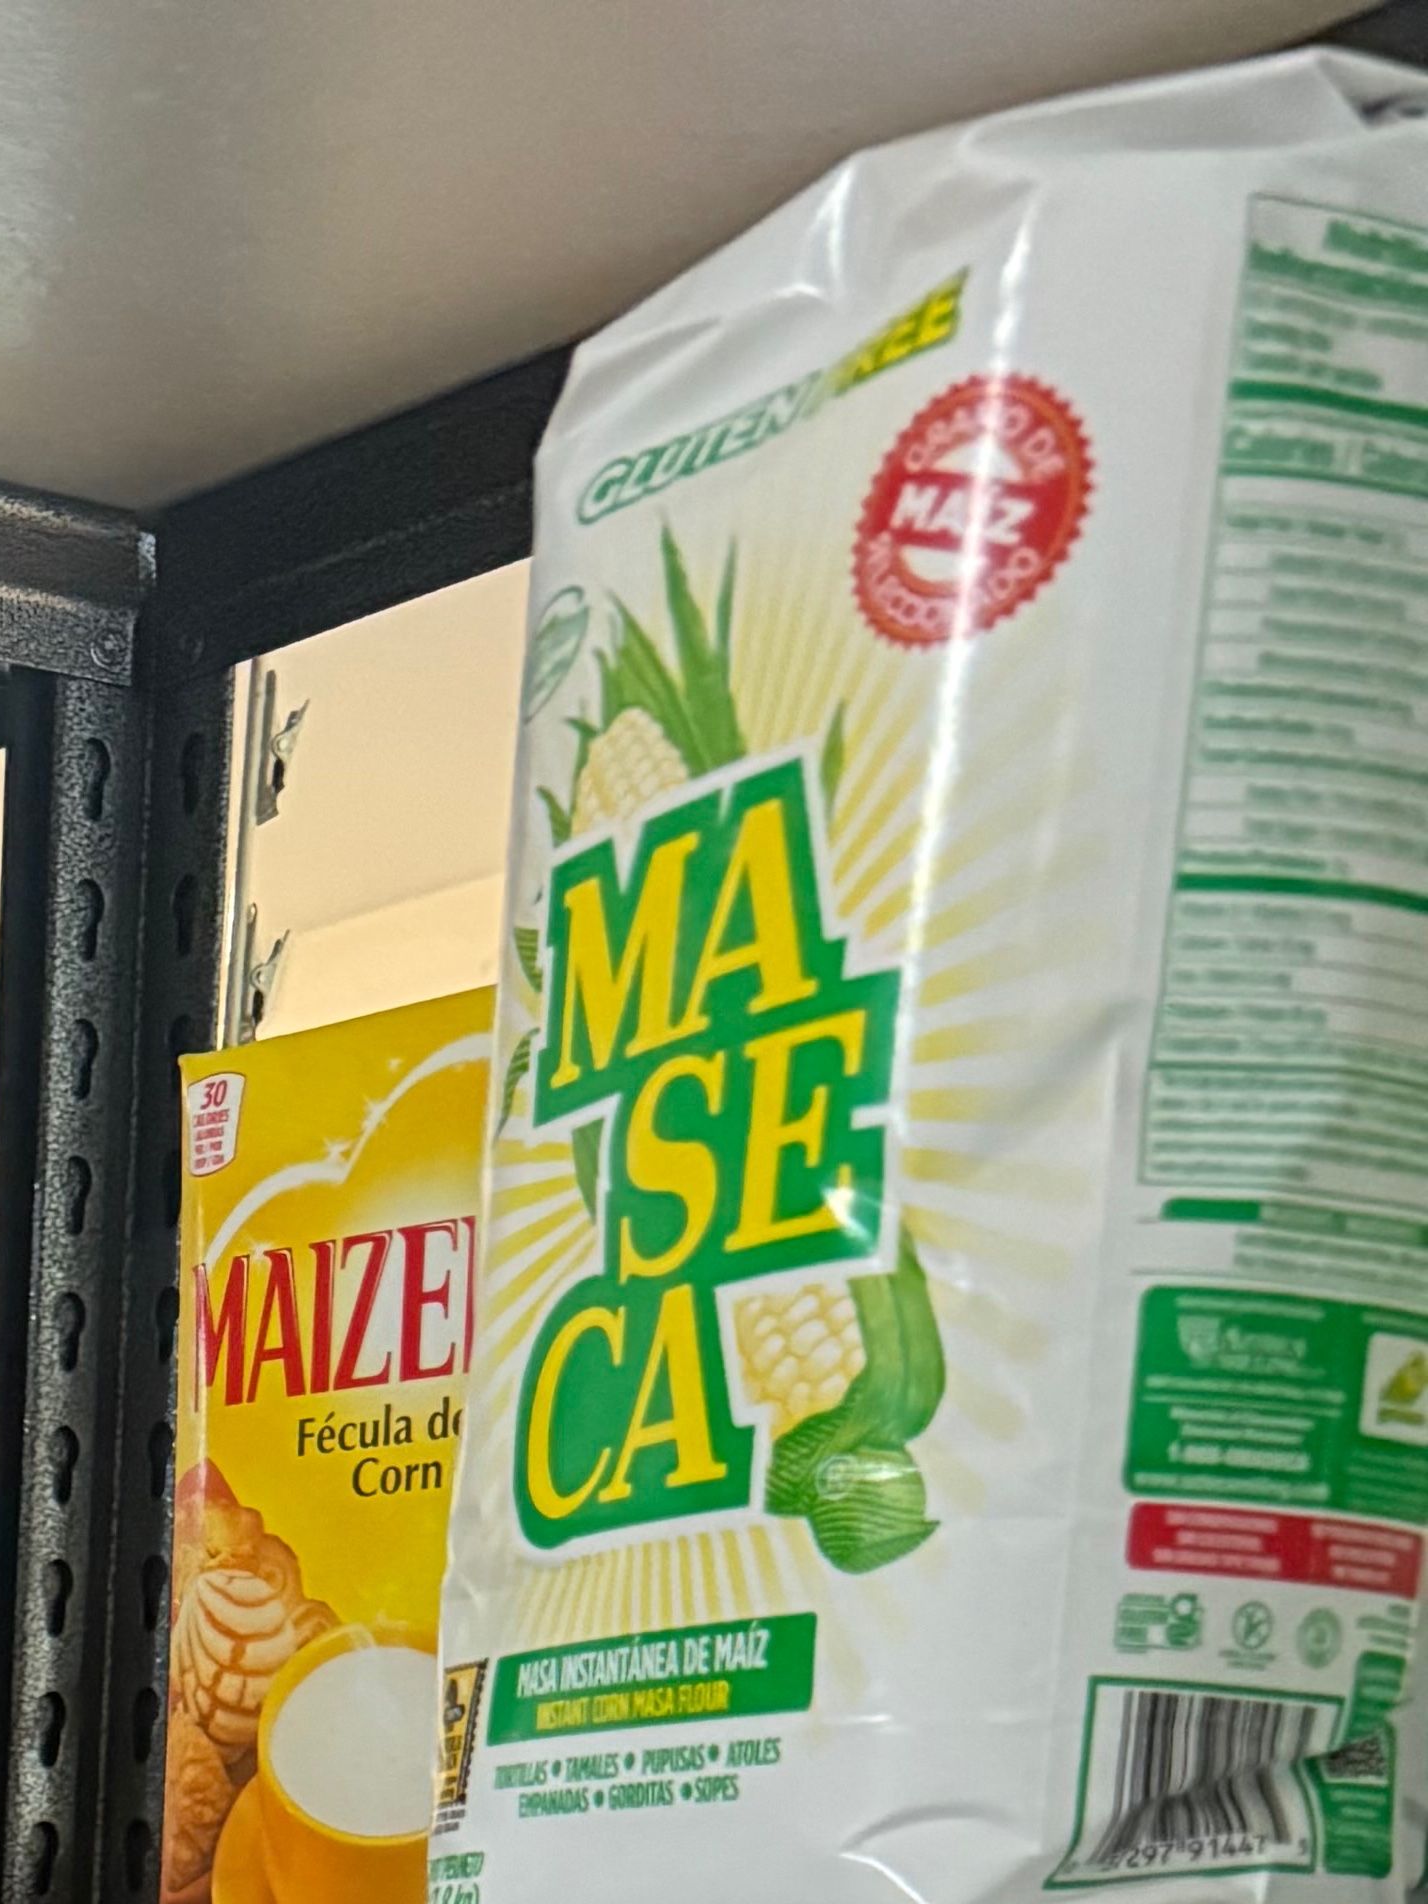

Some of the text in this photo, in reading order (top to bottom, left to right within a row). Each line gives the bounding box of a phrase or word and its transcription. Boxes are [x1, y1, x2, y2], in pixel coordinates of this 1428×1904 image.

[578, 374, 816, 526] GLUTEN
[548, 797, 822, 1091] MA
[199, 1078, 229, 1111] 30
[617, 1007, 869, 1286] SE
[526, 1281, 729, 1522] CA
[296, 1404, 417, 1458] Fécula
[350, 1454, 444, 1498] Corn
[516, 1619, 772, 1699] MASA INSTANTÁNEA DE MAÍZ
[631, 1685, 674, 1721] MASA
[676, 1678, 731, 1716] FLOUR
[494, 1736, 782, 1791] TORTILLAS TAMALES PUPUSAS ATOLES
[518, 1773, 740, 1820] EMPANADAS GORDITAS SOPES
